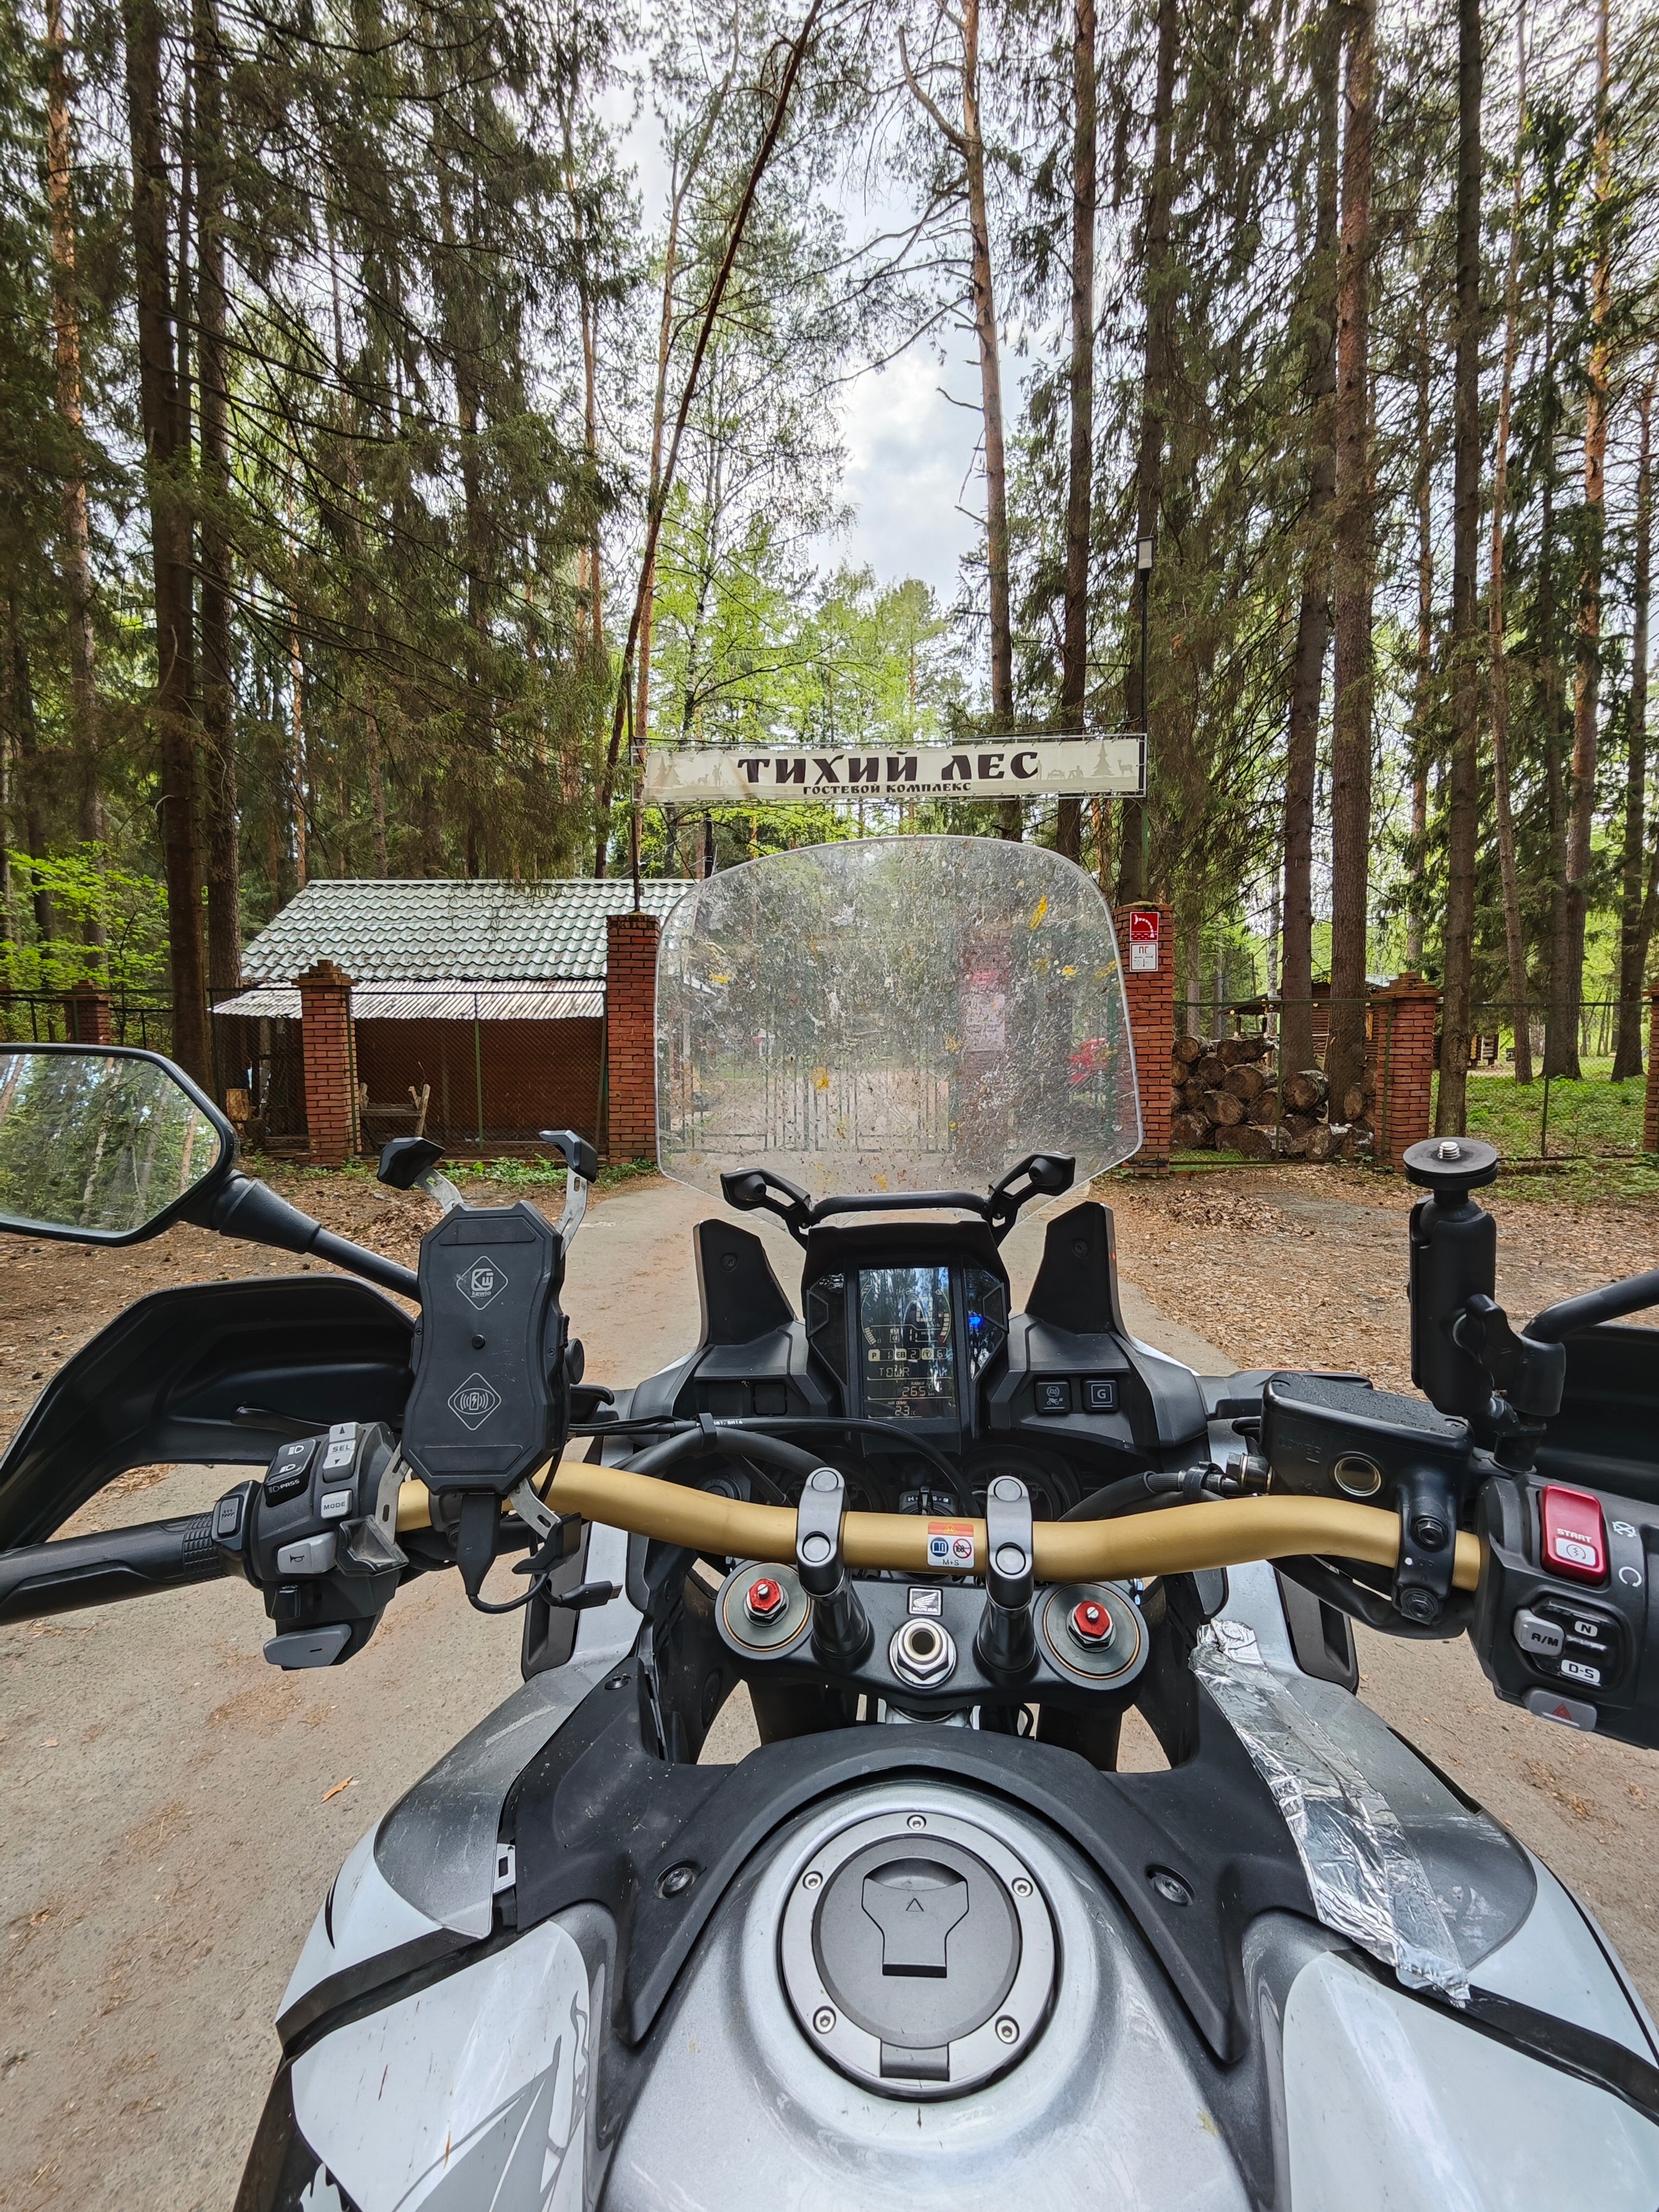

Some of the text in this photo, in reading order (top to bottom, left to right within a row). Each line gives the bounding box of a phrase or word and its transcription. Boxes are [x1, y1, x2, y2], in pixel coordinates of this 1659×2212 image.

[737, 751, 1038, 785] ТИХИЙ ЛЕС
[803, 782, 971, 795] ГОСТЕВОЙ КОМПЛЕКС
[910, 1350, 916, 1359] 2
[937, 1350, 943, 1359] 6
[902, 1387, 925, 1397] 265
[1097, 1389, 1107, 1399] G
[895, 1406, 910, 1416] 23
[332, 1444, 351, 1453] SEL
[280, 1479, 300, 1489] PASS
[323, 1501, 346, 1510] MODE
[1557, 1528, 1592, 1542] START
[1581, 1624, 1592, 1634] N
[1568, 1663, 1594, 1679] D-S
